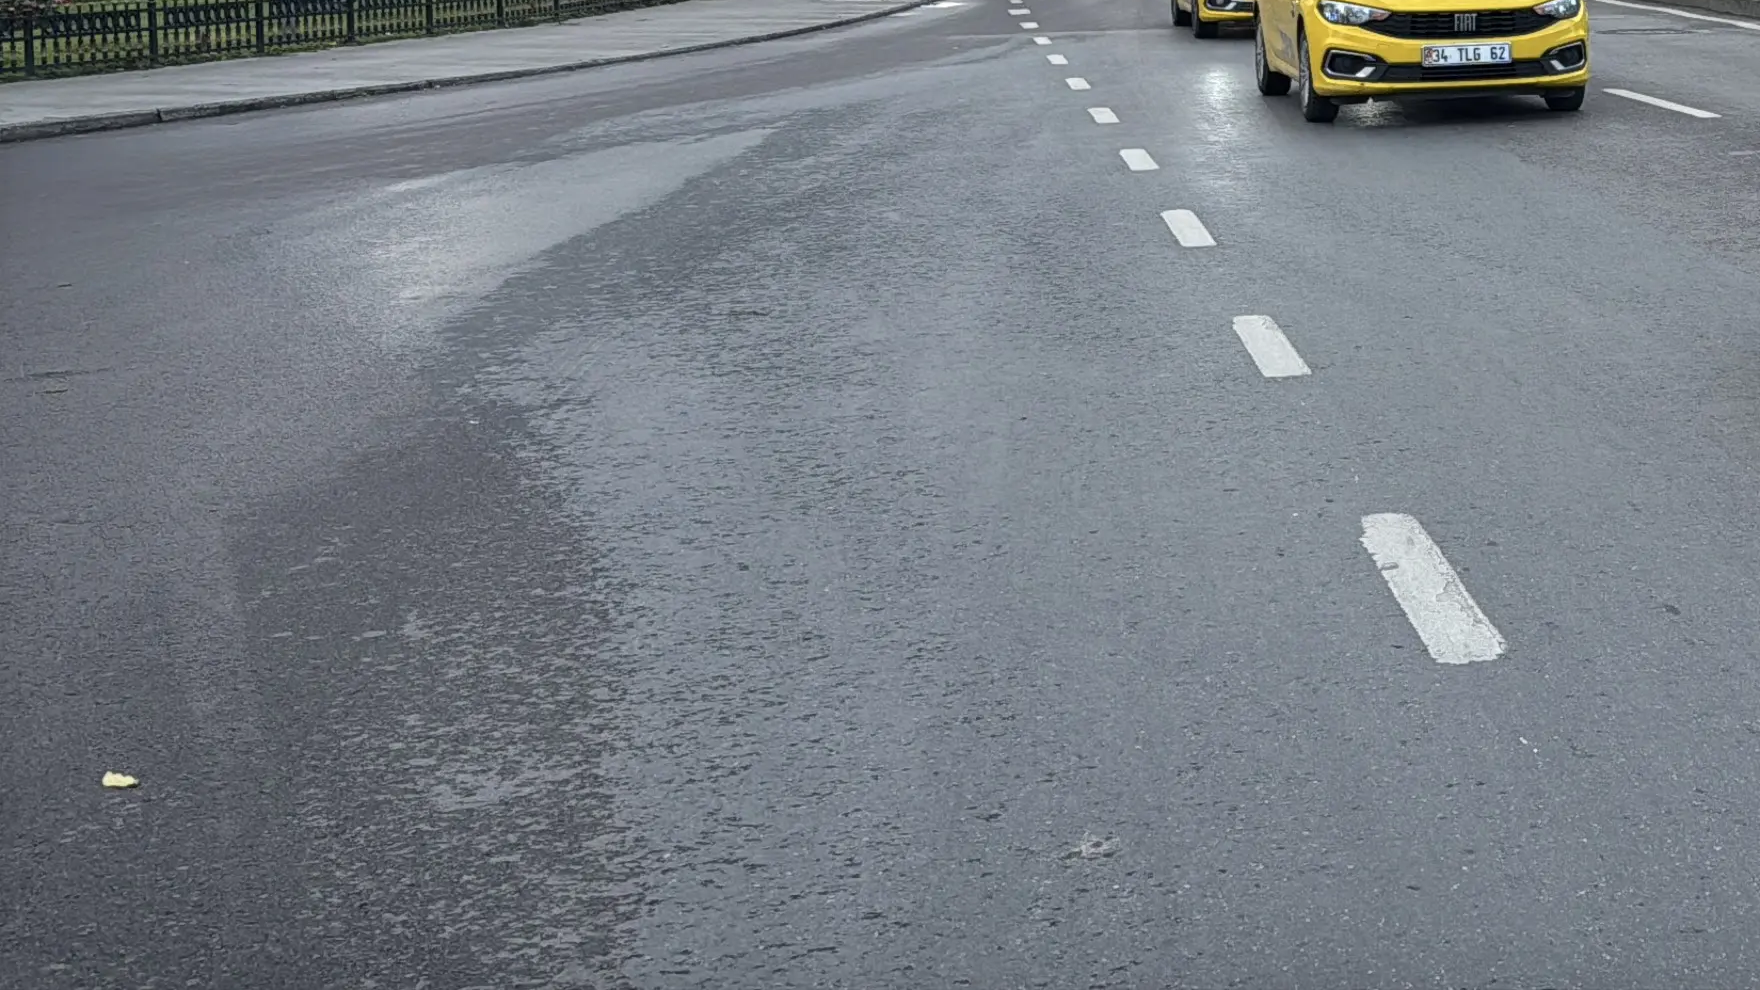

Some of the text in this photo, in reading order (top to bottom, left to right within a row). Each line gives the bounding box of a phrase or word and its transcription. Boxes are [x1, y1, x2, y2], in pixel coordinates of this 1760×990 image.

[1454, 14, 1478, 31] FIAT
[1433, 46, 1505, 63] 34 TLG 62
